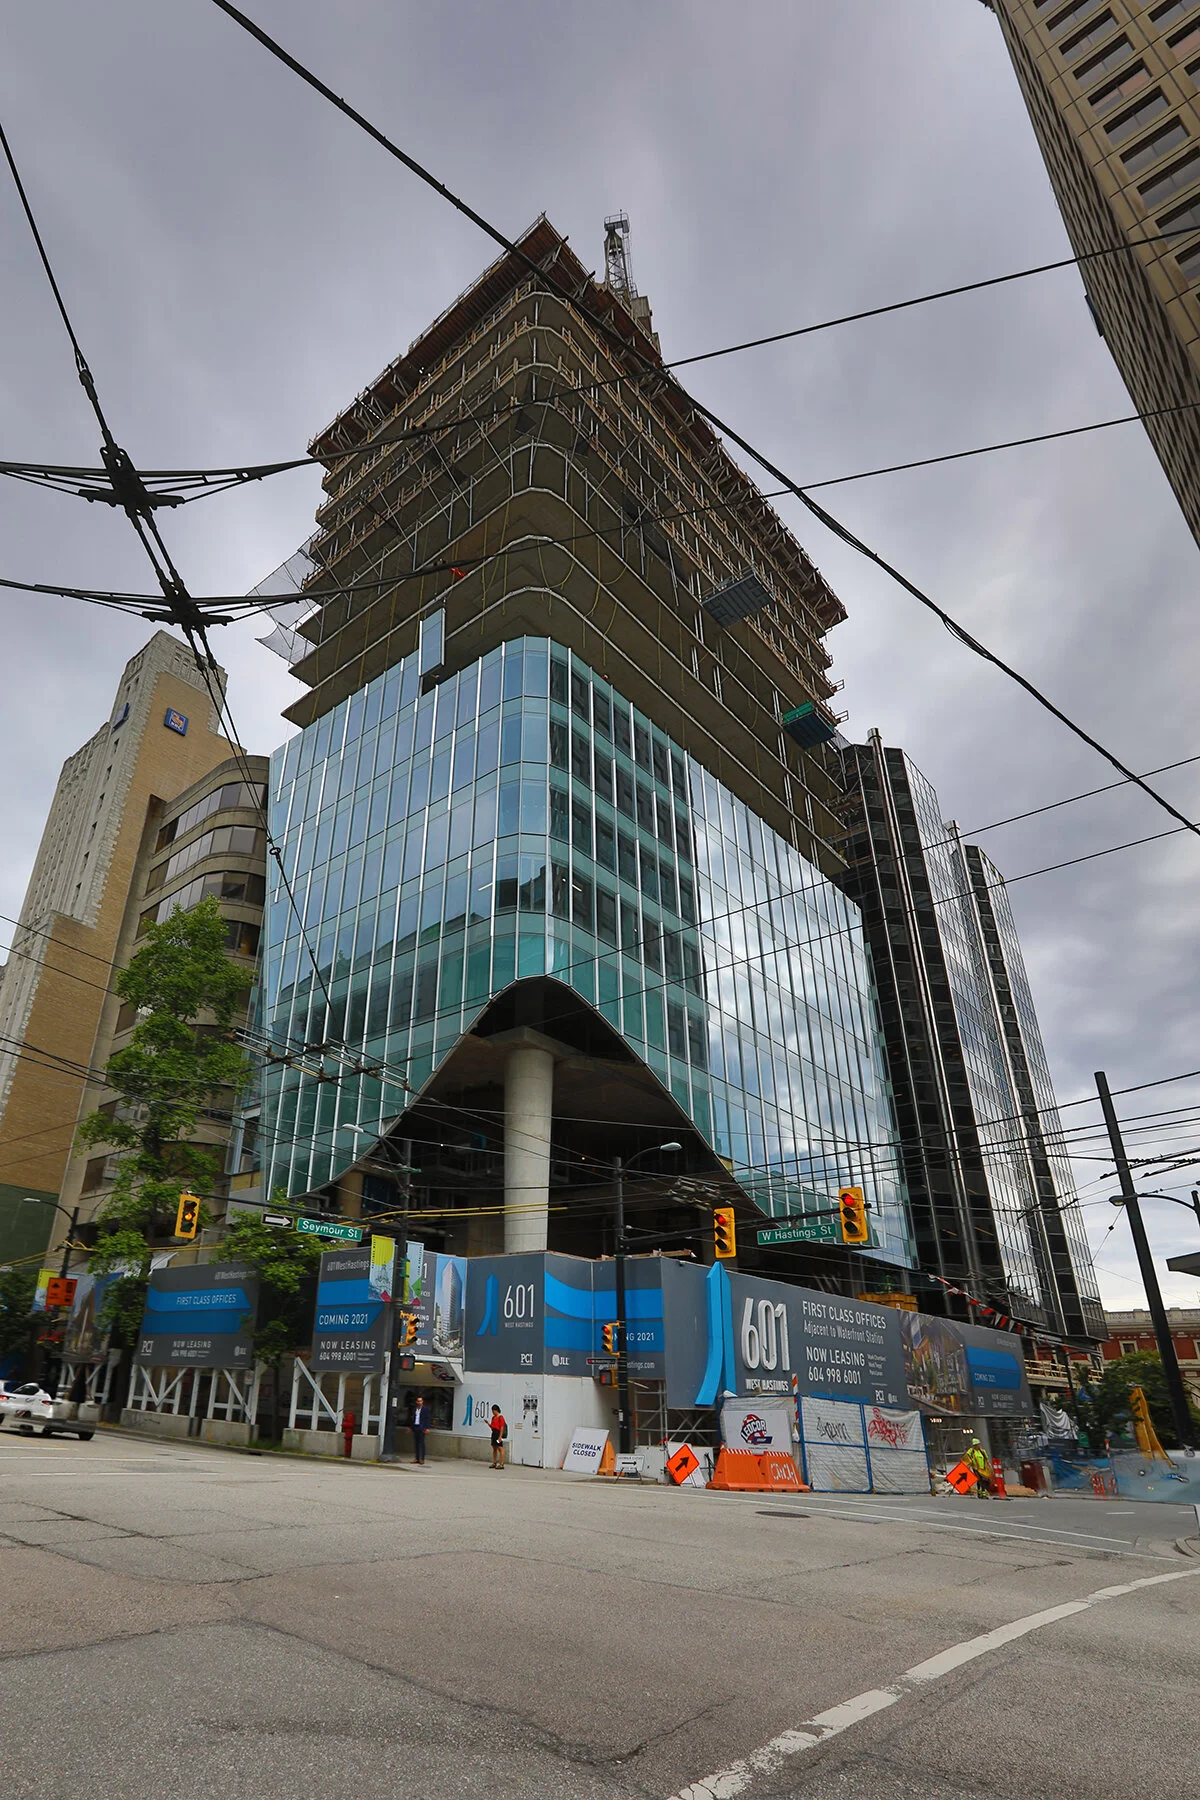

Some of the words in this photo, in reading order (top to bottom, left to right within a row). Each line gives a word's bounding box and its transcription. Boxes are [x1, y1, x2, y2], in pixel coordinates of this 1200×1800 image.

[302, 1220, 344, 1235] Seymour
[347, 1230, 358, 1238] St
[762, 1232, 771, 1240] W
[775, 1229, 816, 1239] Hastings
[820, 1225, 832, 1235] St
[176, 1296, 192, 1305] FIRST
[193, 1296, 211, 1305] CLASS
[211, 1294, 237, 1304] OFFICES
[504, 1284, 534, 1318] 601
[319, 1314, 349, 1325] COMING
[351, 1313, 368, 1325] 2021
[802, 1301, 826, 1319] FIRST
[828, 1306, 854, 1324] CLASS
[855, 1312, 887, 1329] OFFICES
[637, 1332, 655, 1341] 2021
[741, 1297, 790, 1371] 601
[803, 1320, 829, 1337] Adjacent
[829, 1324, 836, 1338] to
[836, 1325, 865, 1343] Waterfront
[865, 1330, 884, 1345] Station
[320, 1341, 338, 1349] NOW
[340, 1341, 376, 1350] LEASING
[319, 1352, 330, 1360] 604
[331, 1352, 342, 1360] 998
[342, 1352, 356, 1360] 6001
[520, 1353, 533, 1363] PCI
[806, 1346, 827, 1362] NOW
[829, 1349, 865, 1367] LEASING
[808, 1366, 824, 1382] 604
[826, 1368, 842, 1383] 998
[843, 1369, 862, 1385] 6001
[875, 1390, 885, 1401] PCI
[474, 1401, 489, 1419] 601
[741, 1420, 767, 1441] LEDCOR
[572, 1442, 602, 1452] SIDEWALK
[573, 1449, 597, 1457] CLOSED
